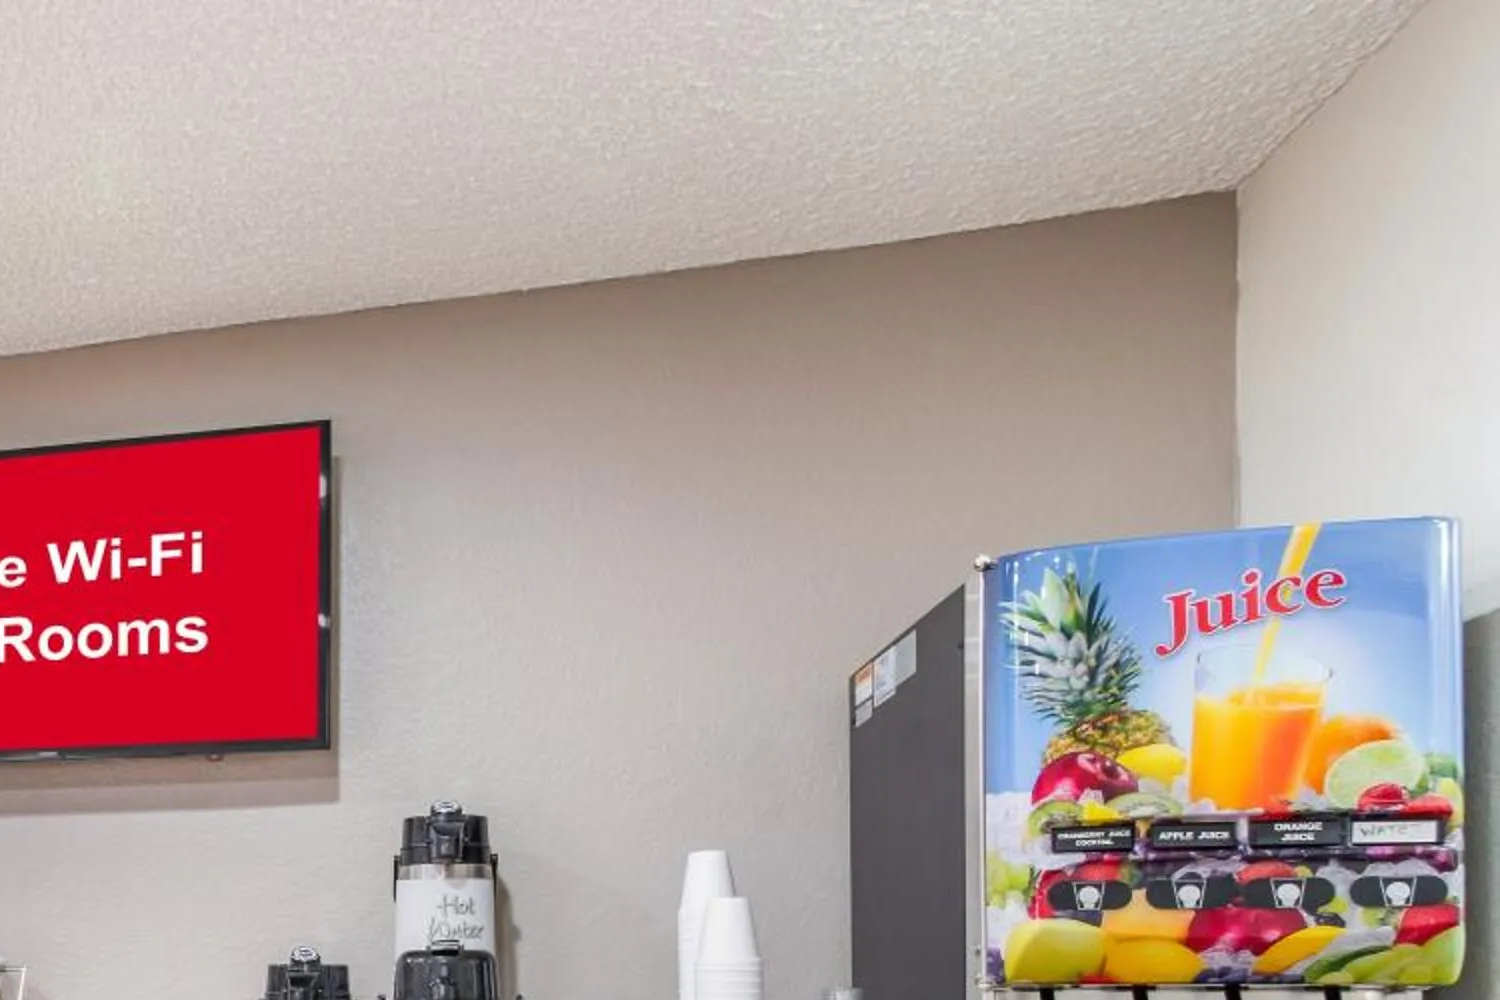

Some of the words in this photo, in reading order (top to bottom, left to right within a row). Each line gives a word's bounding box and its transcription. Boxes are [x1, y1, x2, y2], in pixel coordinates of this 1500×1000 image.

[46, 530, 203, 584] Wi-Fi
[1153, 568, 1348, 659] Juice
[1273, 821, 1323, 832] ORANGE
[1158, 831, 1194, 841] APPLE
[1197, 830, 1231, 840] JUICE
[1281, 832, 1316, 841] JUICE
[437, 894, 476, 917] Hot
